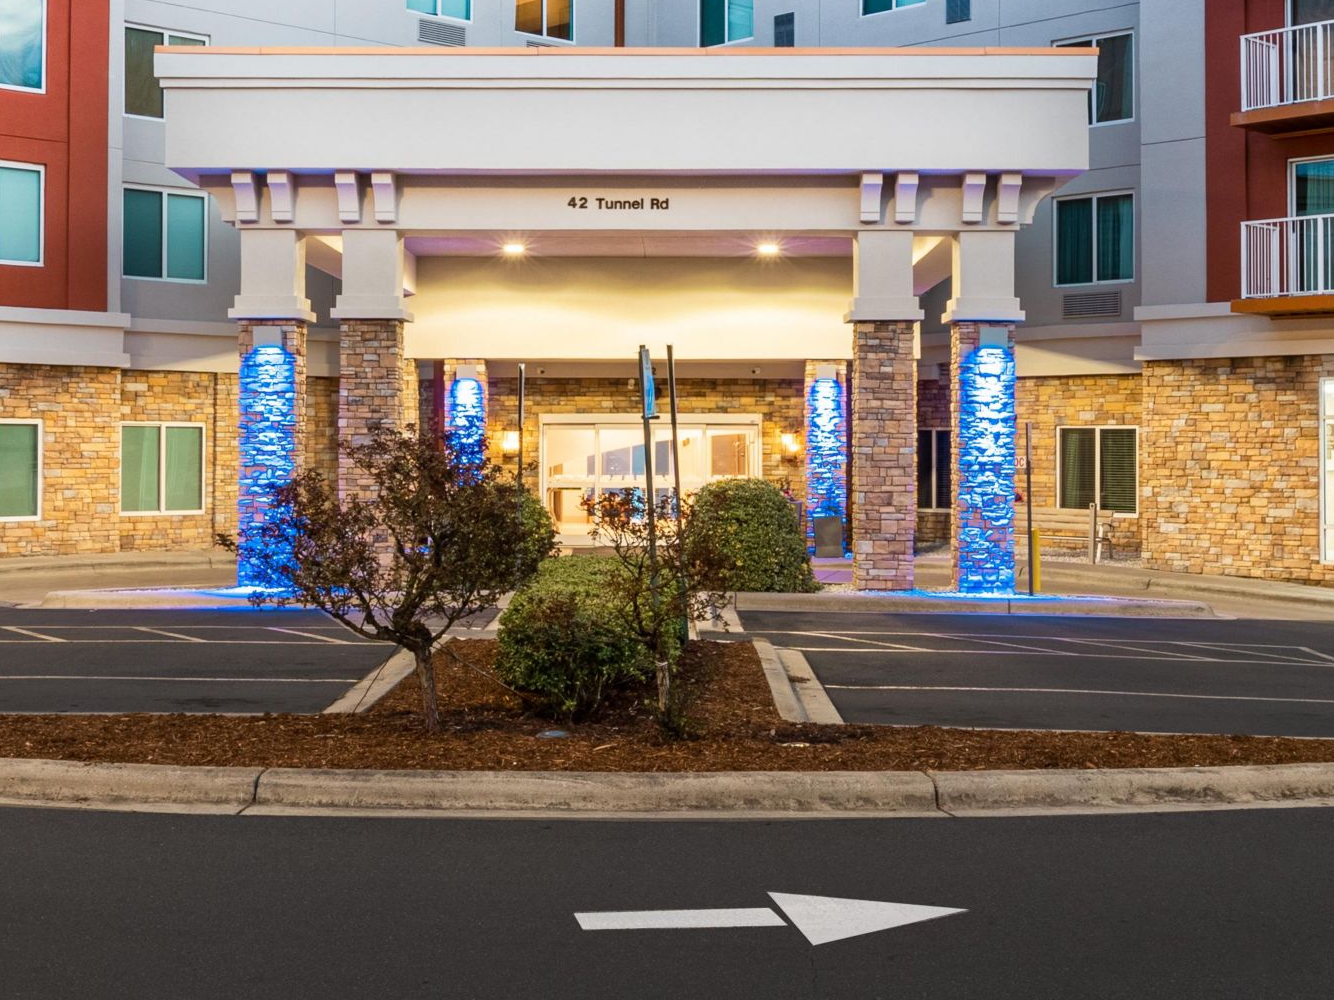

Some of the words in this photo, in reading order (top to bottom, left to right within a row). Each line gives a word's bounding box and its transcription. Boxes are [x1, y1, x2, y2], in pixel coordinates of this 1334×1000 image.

[567, 196, 588, 209] 42
[595, 197, 644, 210] Tunnel
[650, 197, 669, 210] Rd
